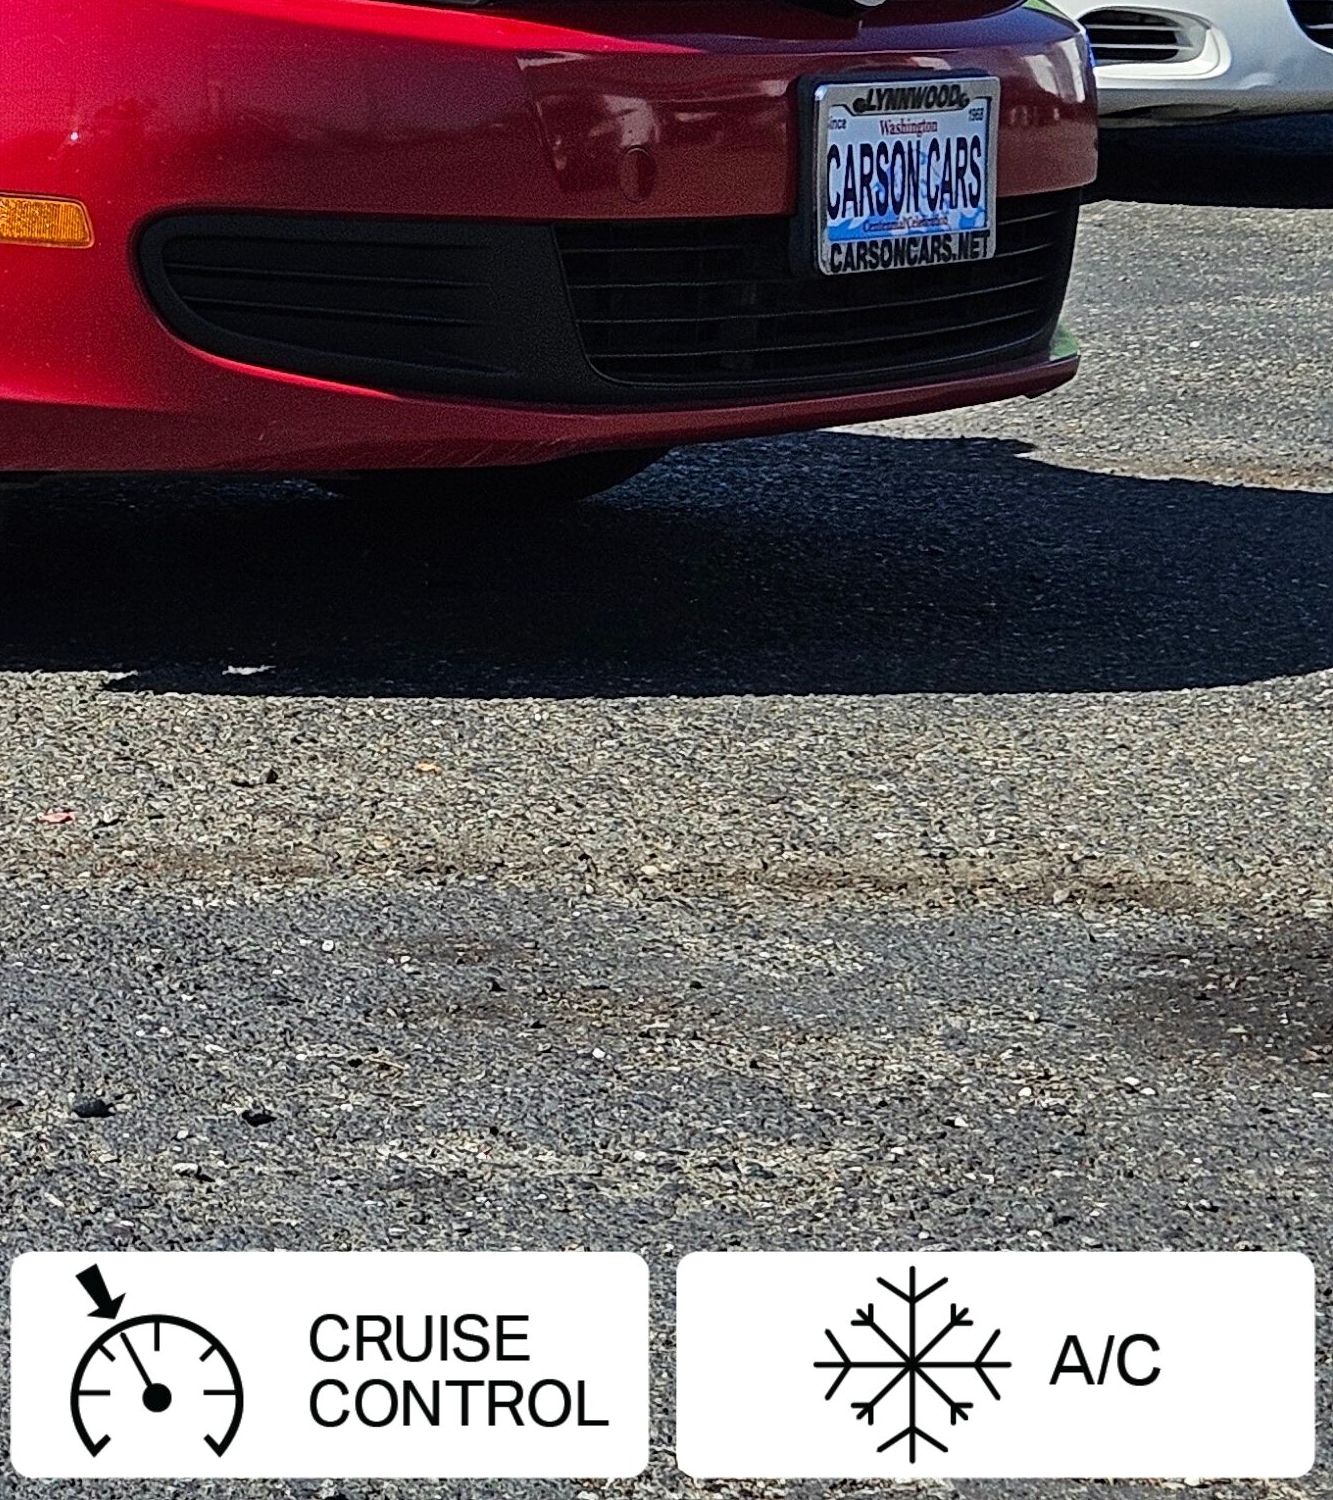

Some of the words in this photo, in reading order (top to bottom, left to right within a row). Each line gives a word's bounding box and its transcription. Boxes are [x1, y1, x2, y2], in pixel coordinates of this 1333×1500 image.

[865, 84, 962, 113] LYNNWOOD
[879, 118, 939, 137] Washington
[826, 139, 921, 221] CARSON
[926, 134, 983, 212] CARS
[829, 229, 991, 274] CARSONCARS.NET
